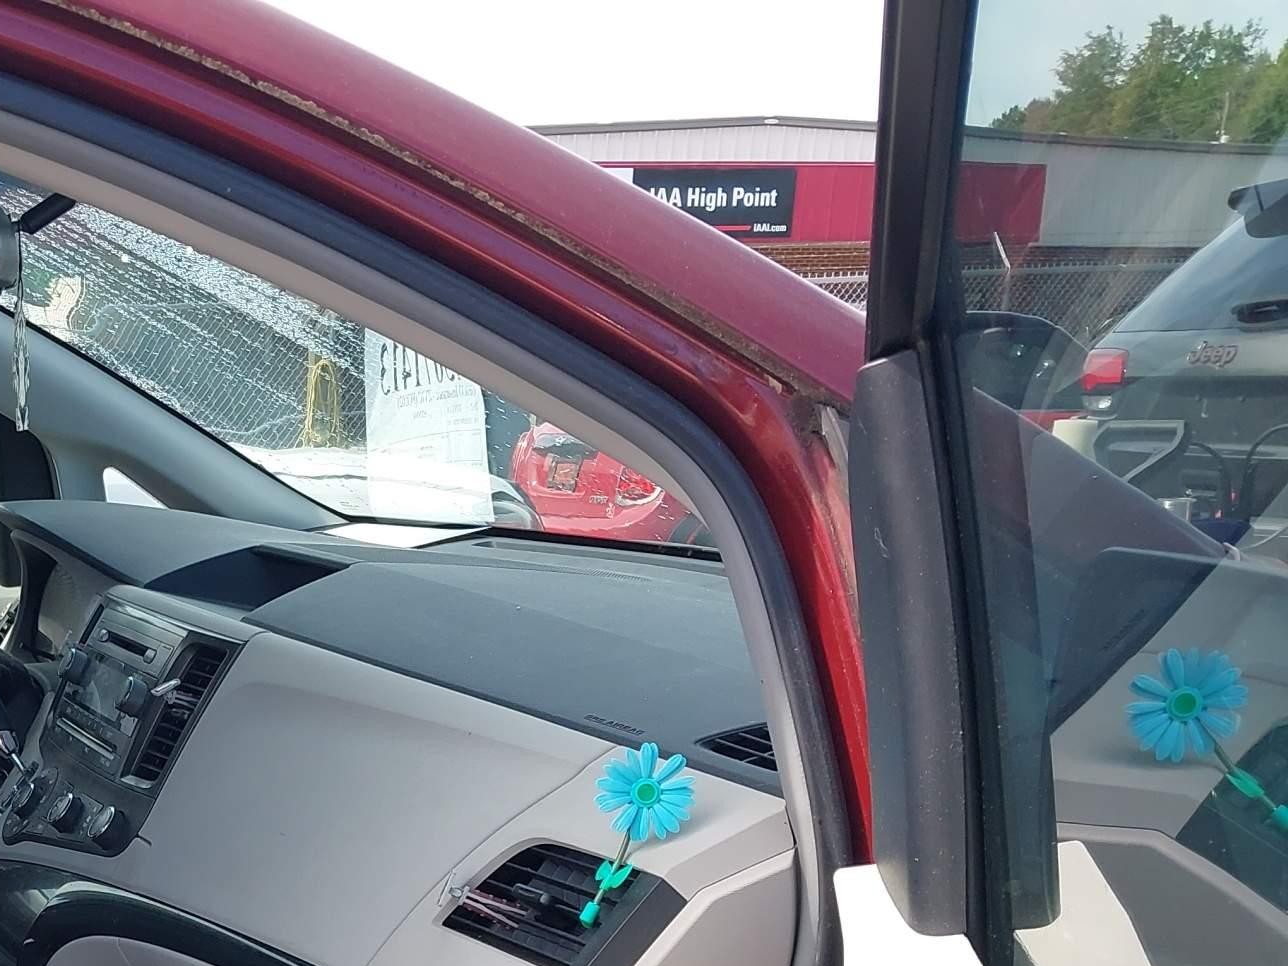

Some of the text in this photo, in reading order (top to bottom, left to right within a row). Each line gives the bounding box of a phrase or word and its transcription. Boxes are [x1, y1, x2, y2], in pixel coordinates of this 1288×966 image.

[687, 187, 727, 212] High
[732, 187, 778, 207] Point
[1186, 340, 1239, 368] Jeep
